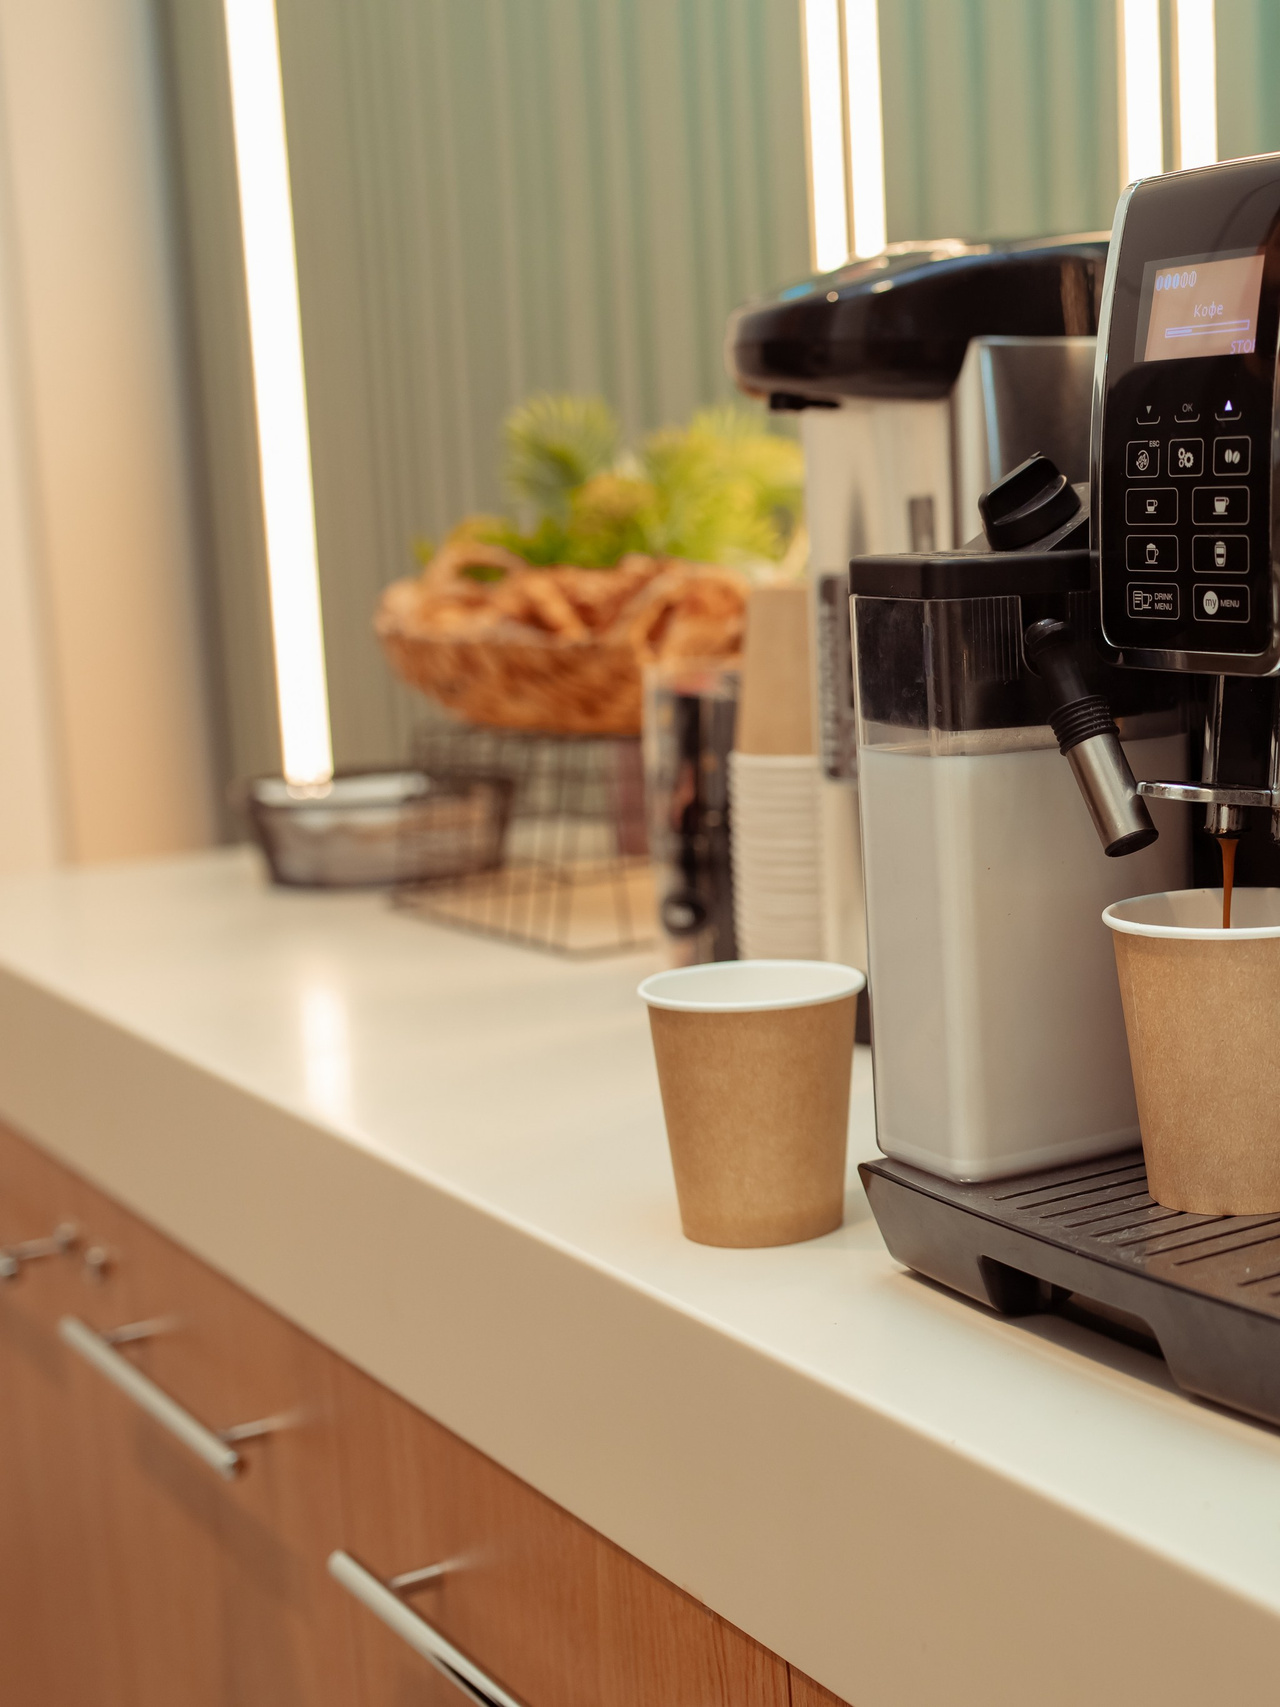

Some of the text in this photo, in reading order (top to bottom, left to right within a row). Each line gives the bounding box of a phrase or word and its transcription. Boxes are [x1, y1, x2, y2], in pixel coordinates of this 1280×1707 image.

[1193, 301, 1224, 318] Кофе
[1182, 403, 1193, 413] OK
[1149, 440, 1160, 448] ESC
[1154, 592, 1173, 601] DRINK
[1154, 602, 1173, 611] MENU
[1205, 598, 1240, 609] my MENU
